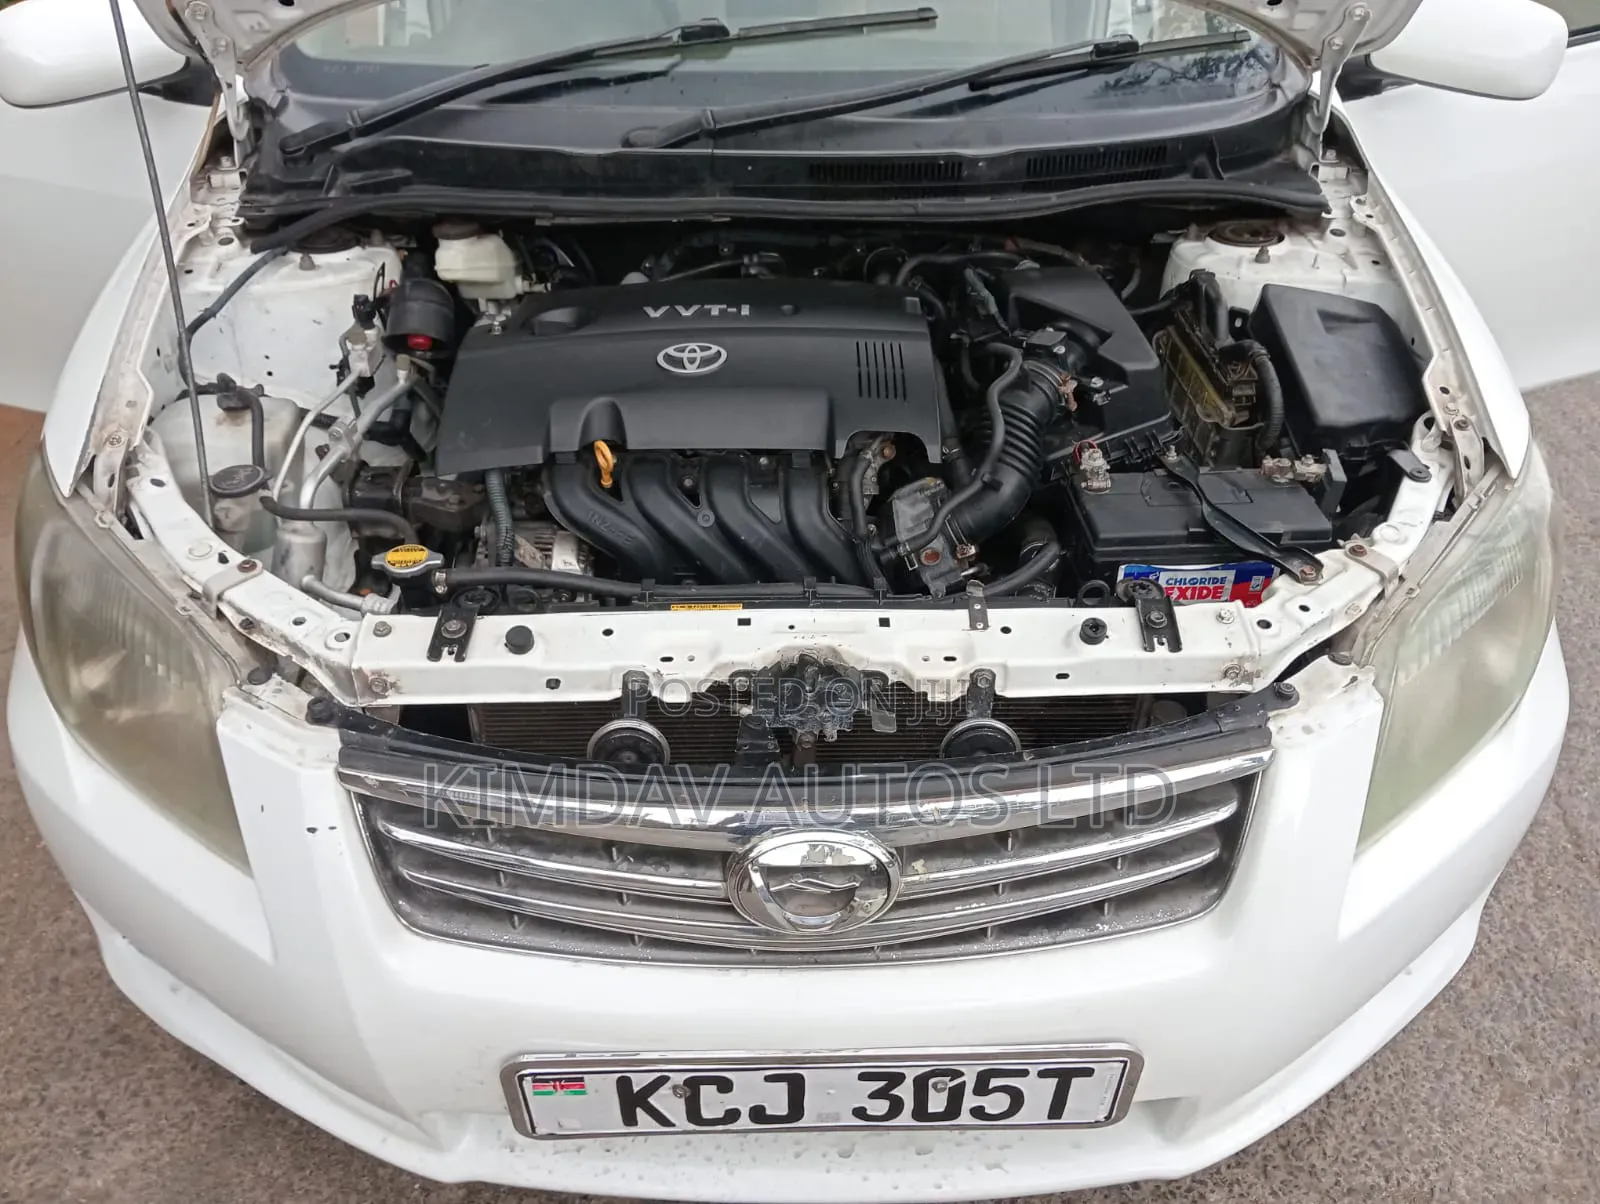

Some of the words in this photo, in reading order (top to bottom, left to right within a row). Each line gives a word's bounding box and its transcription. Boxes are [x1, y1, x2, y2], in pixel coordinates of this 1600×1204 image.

[1165, 576, 1228, 586] CHLORIDE
[1163, 586, 1225, 600] EXIDE
[616, 1073, 806, 1128] KCJ
[851, 1066, 1096, 1123] 305T
